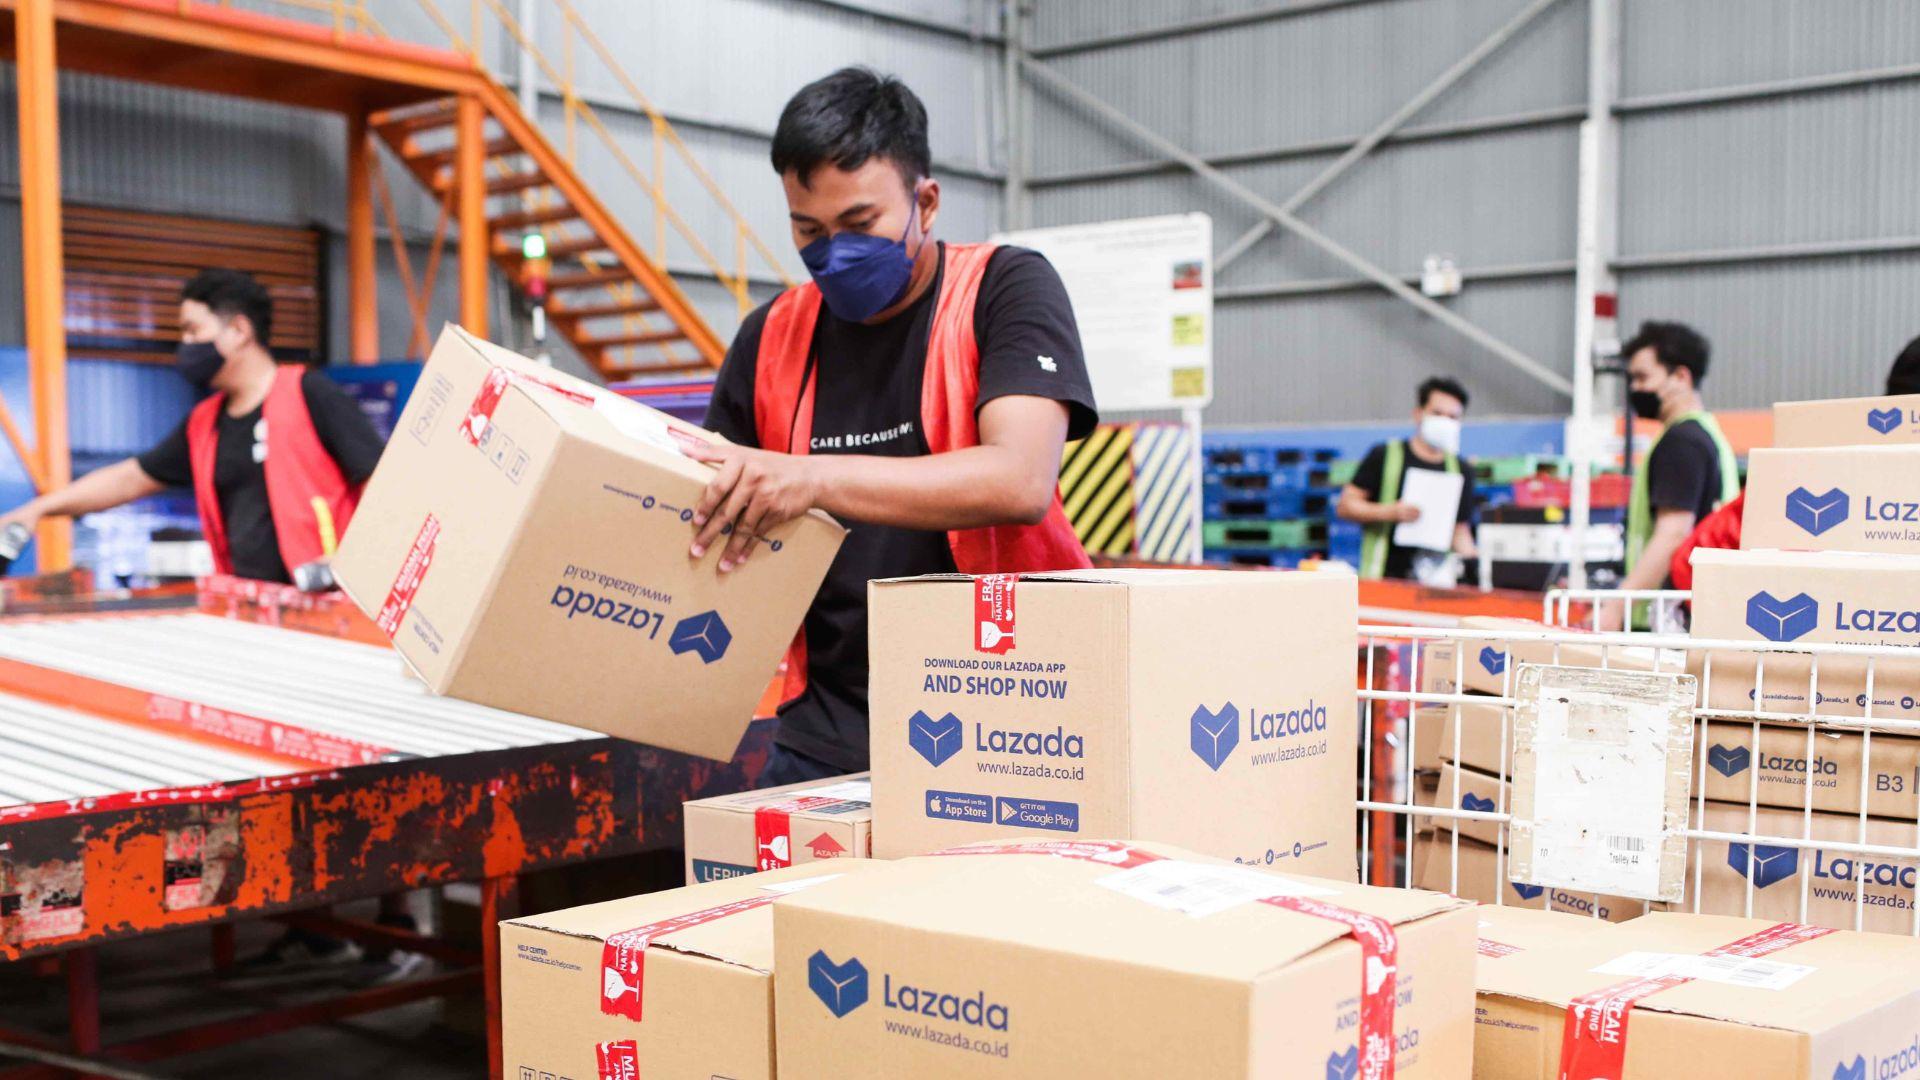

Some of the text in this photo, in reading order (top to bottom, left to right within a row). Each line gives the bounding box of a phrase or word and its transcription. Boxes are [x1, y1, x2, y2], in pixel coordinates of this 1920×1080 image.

[810, 436, 841, 449] CARE
[845, 427, 898, 447] BECAUSE
[1865, 496, 1920, 522] Laz
[563, 564, 672, 605] www.lazada.co.id
[550, 585, 665, 640] Lazada
[924, 658, 1066, 673] DOWNLOAD OUR LAZADA APP
[923, 674, 1067, 700] AND SHOP NOW
[1250, 699, 1327, 743] Lazada
[976, 722, 1084, 759] Lazada
[1251, 739, 1327, 768] www.lazada.co.id
[977, 762, 1084, 782] www.lazada.co.id
[1759, 774, 1837, 788] www.laza.co.id
[1876, 774, 1903, 793] B3
[944, 796, 971, 804] Download
[944, 804, 987, 818] App Store
[1020, 811, 1074, 828] Google Play
[884, 973, 1008, 1032] Lazada
[884, 1018, 1008, 1059] www.lazada.co.id
[1873, 1033, 1920, 1080] Lazad
